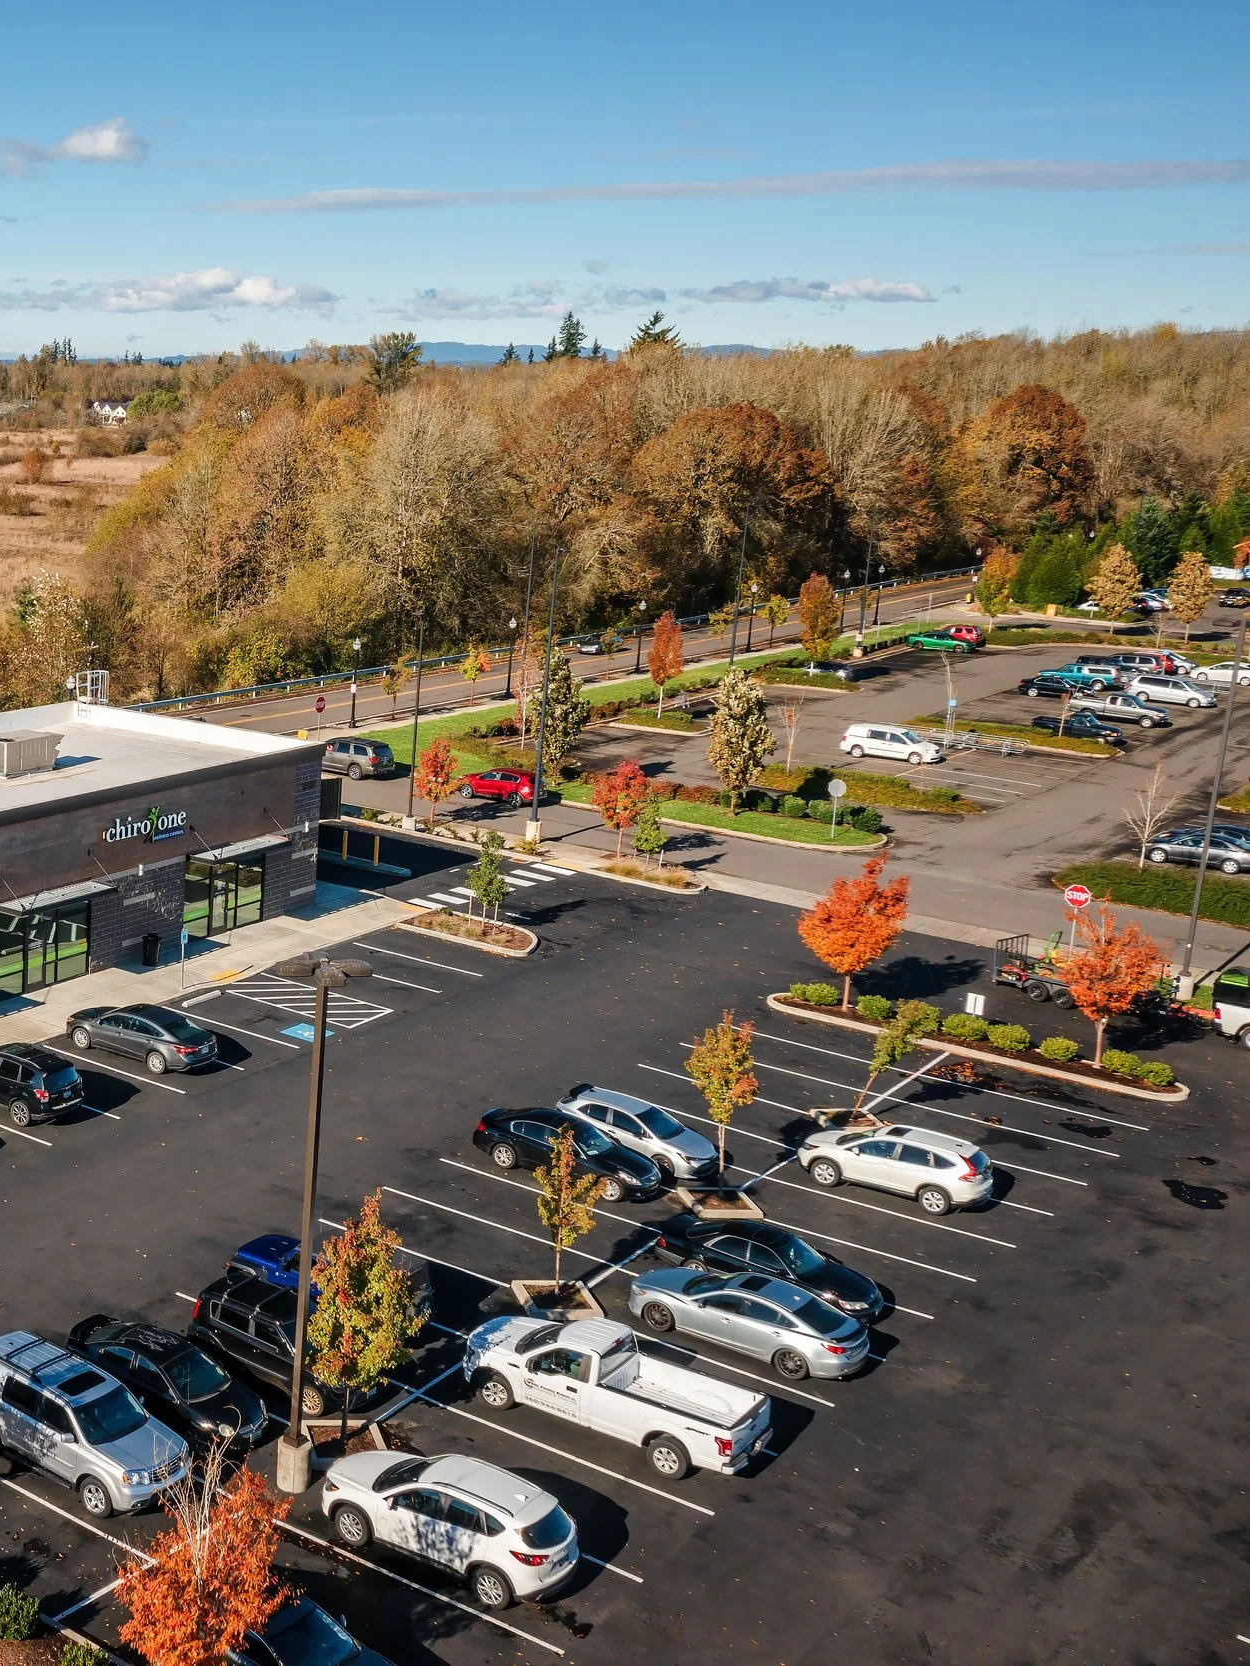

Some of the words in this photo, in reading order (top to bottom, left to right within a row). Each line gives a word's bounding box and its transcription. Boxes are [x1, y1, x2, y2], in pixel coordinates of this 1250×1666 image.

[106, 816, 151, 843] chiro
[157, 811, 187, 831] one
[1066, 891, 1089, 901] STOP
